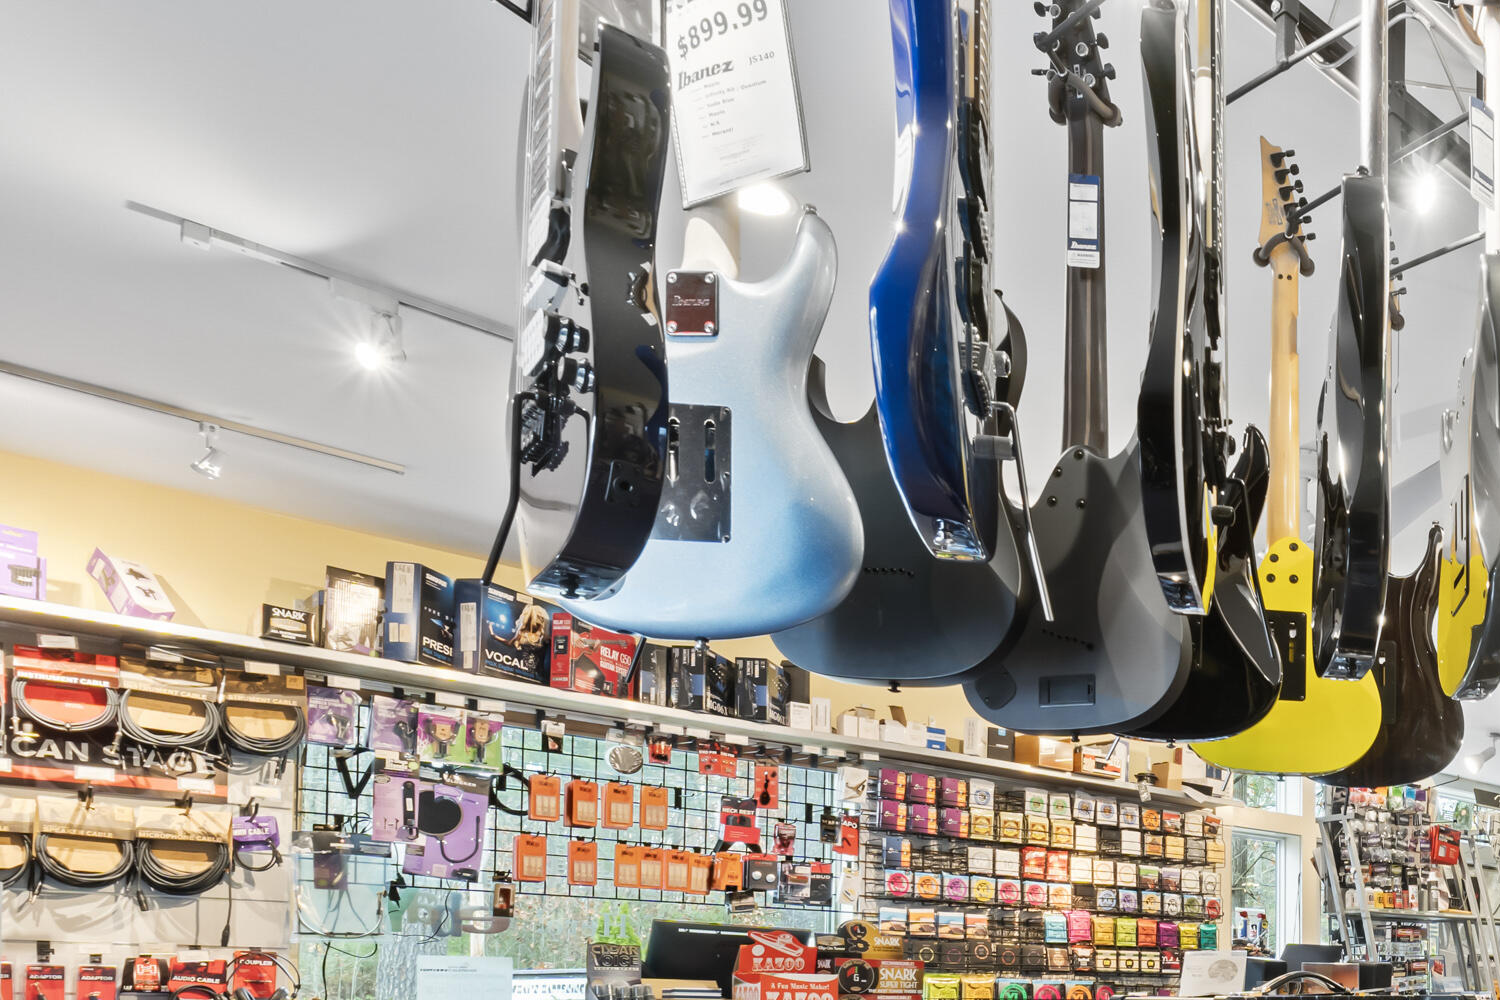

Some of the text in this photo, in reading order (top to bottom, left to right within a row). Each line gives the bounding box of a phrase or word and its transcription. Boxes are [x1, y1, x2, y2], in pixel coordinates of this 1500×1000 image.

[677, 0, 767, 60] $899.99
[678, 60, 734, 91] Ibanez
[272, 607, 305, 621] SNARK
[600, 646, 631, 666] RELAY G50
[79, 677, 110, 687] CABLE
[874, 937, 899, 946] SNARK
[752, 957, 805, 971] KAZOO
[194, 977, 220, 985] CABLE
[880, 967, 917, 981] SNARK
[900, 981, 918, 989] TIGHT
